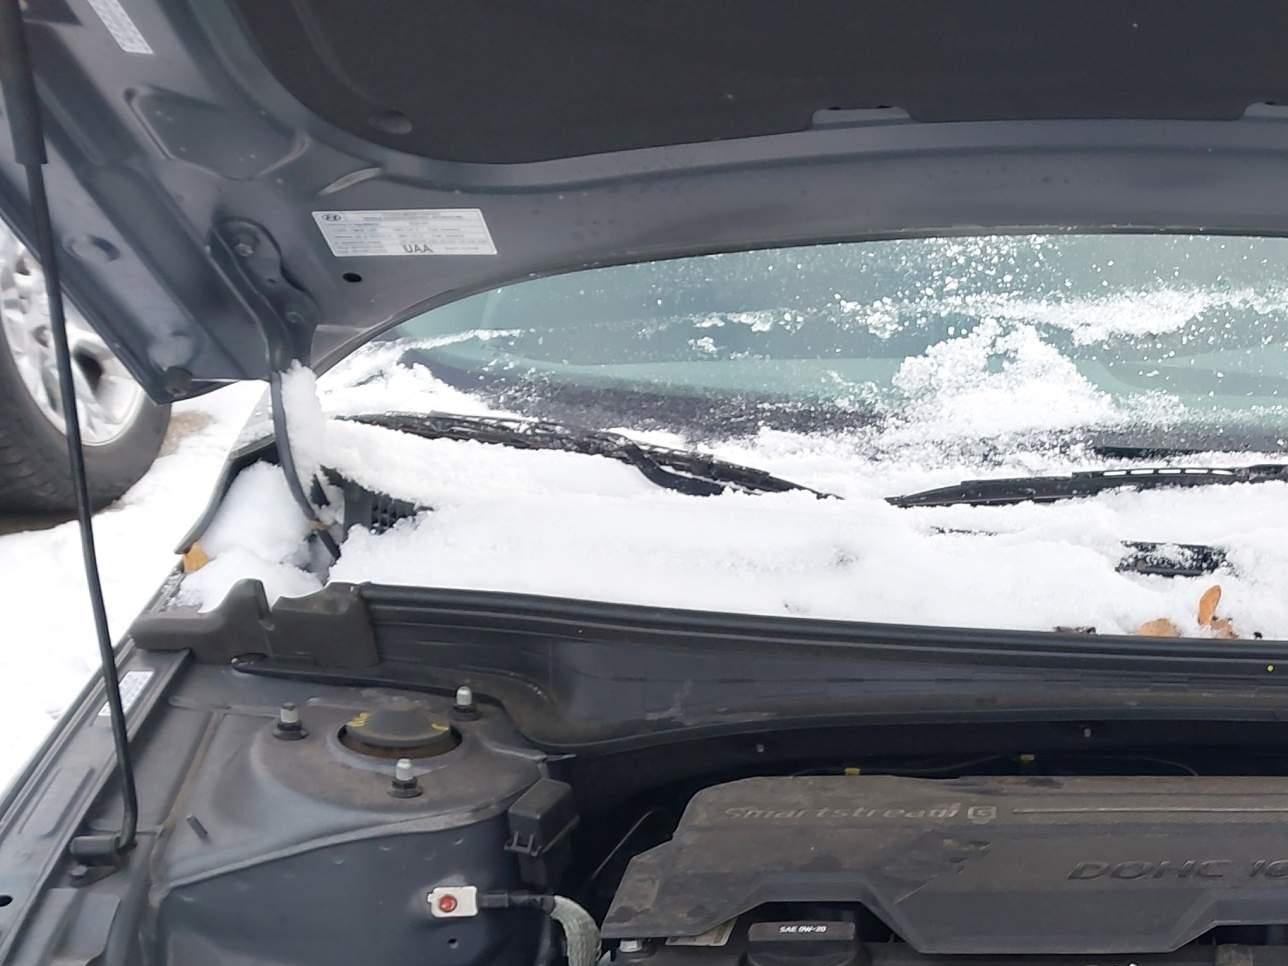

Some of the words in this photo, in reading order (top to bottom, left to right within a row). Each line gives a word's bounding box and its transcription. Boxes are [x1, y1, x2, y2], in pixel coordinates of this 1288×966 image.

[402, 244, 433, 253] UAA
[1067, 860, 1232, 880] DOHC
[779, 925, 798, 933] SAE
